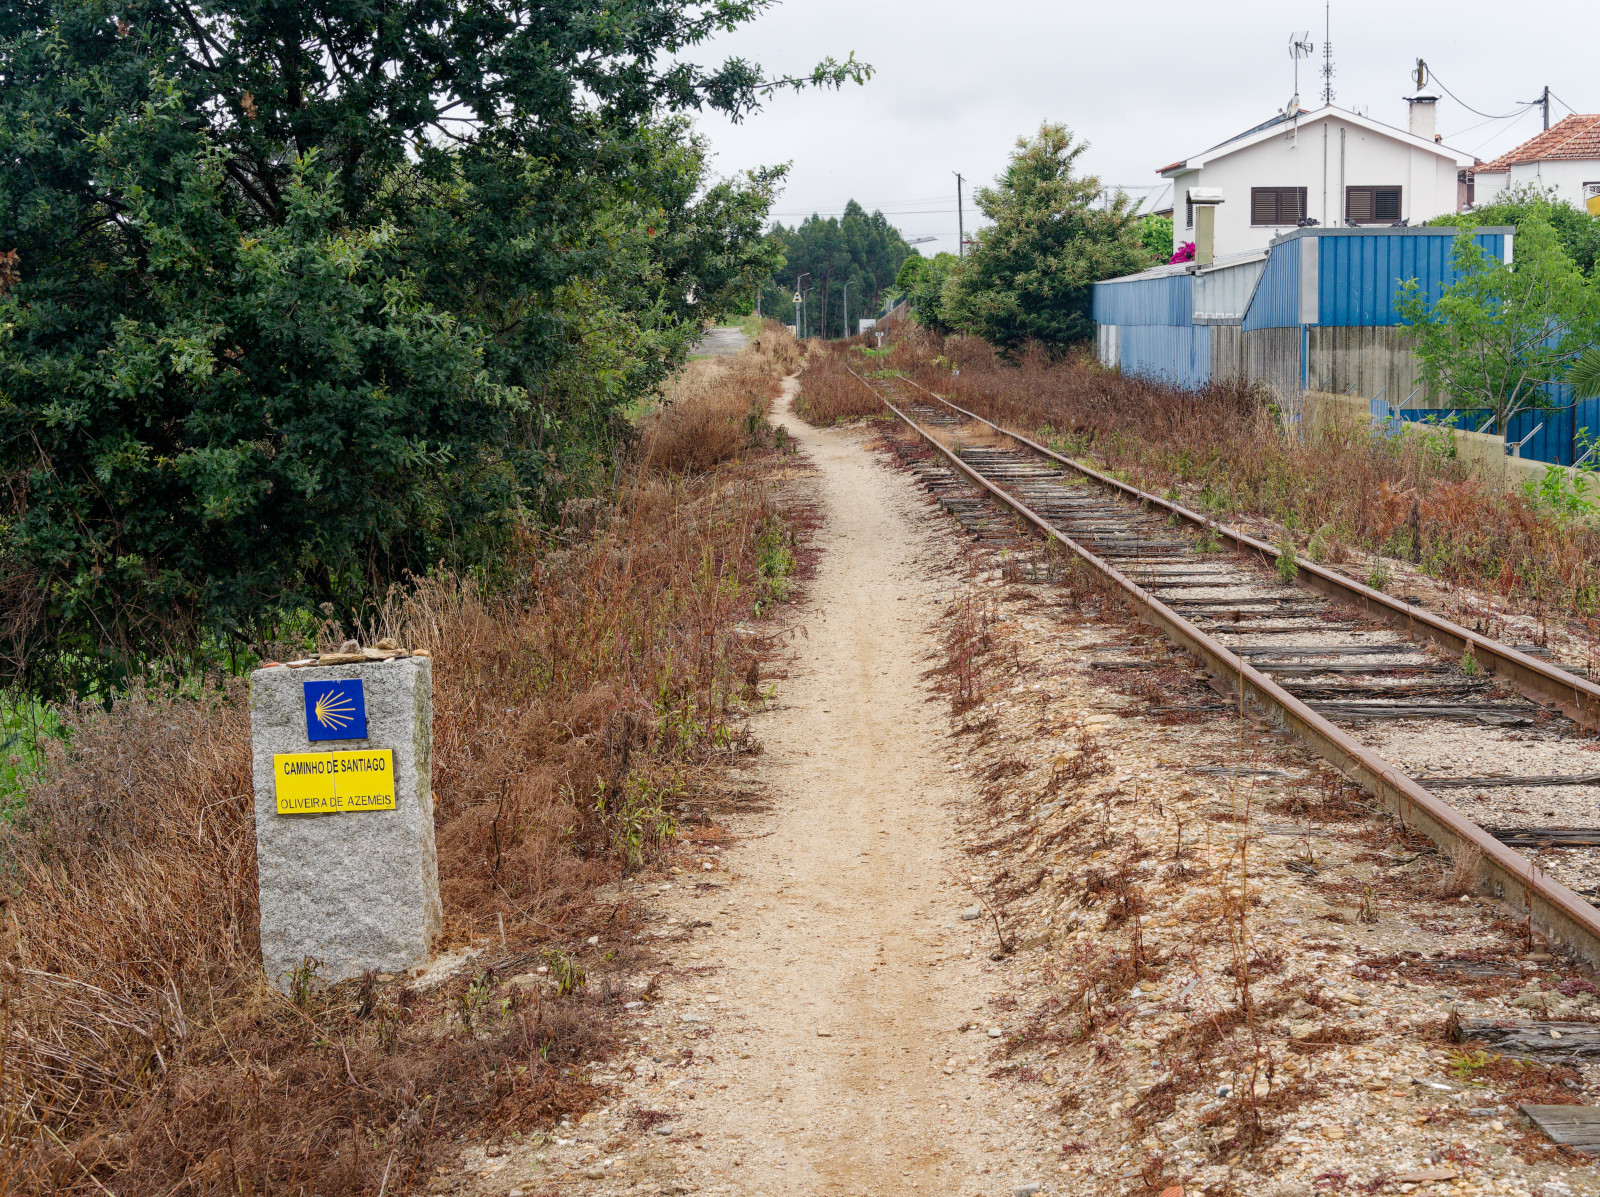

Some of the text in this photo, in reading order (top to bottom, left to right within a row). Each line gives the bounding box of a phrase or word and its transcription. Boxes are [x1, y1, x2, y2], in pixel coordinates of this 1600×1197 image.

[284, 758, 385, 775] CAMINHO DE SANTIAGO
[281, 798, 327, 809] OLIVEIRA
[330, 797, 343, 807] DE
